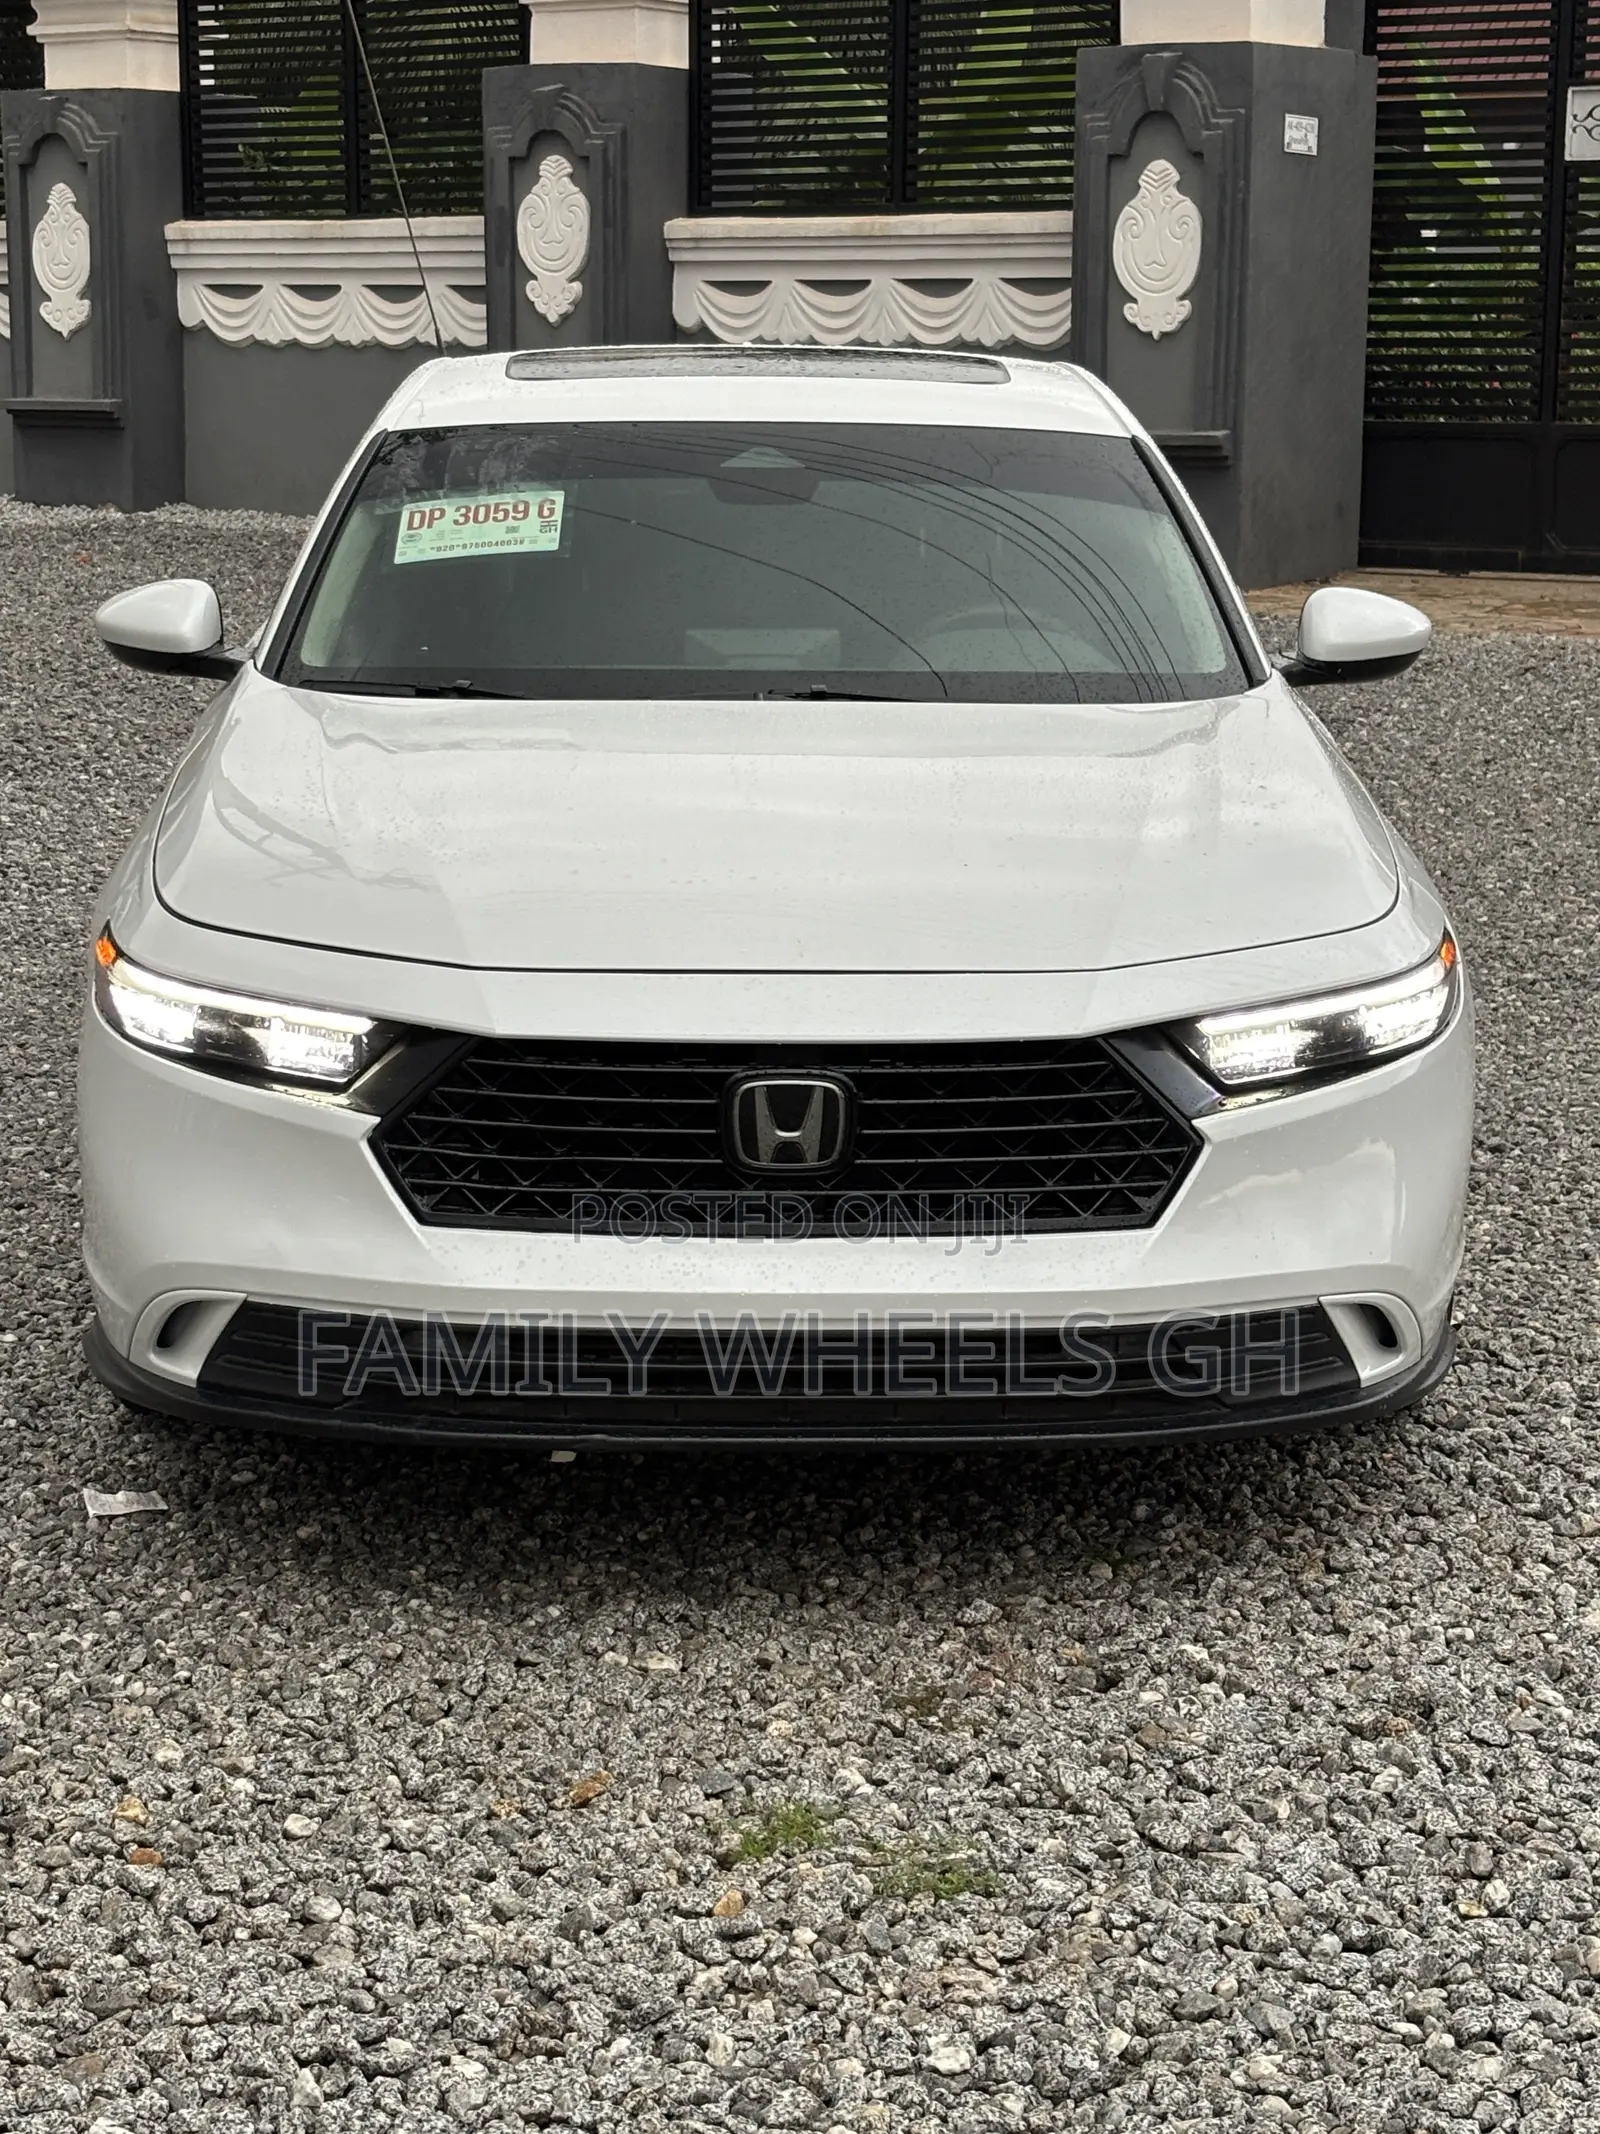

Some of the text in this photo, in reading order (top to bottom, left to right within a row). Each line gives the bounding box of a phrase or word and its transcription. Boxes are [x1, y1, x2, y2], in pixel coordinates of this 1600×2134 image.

[406, 498, 557, 531] DP 3059 G
